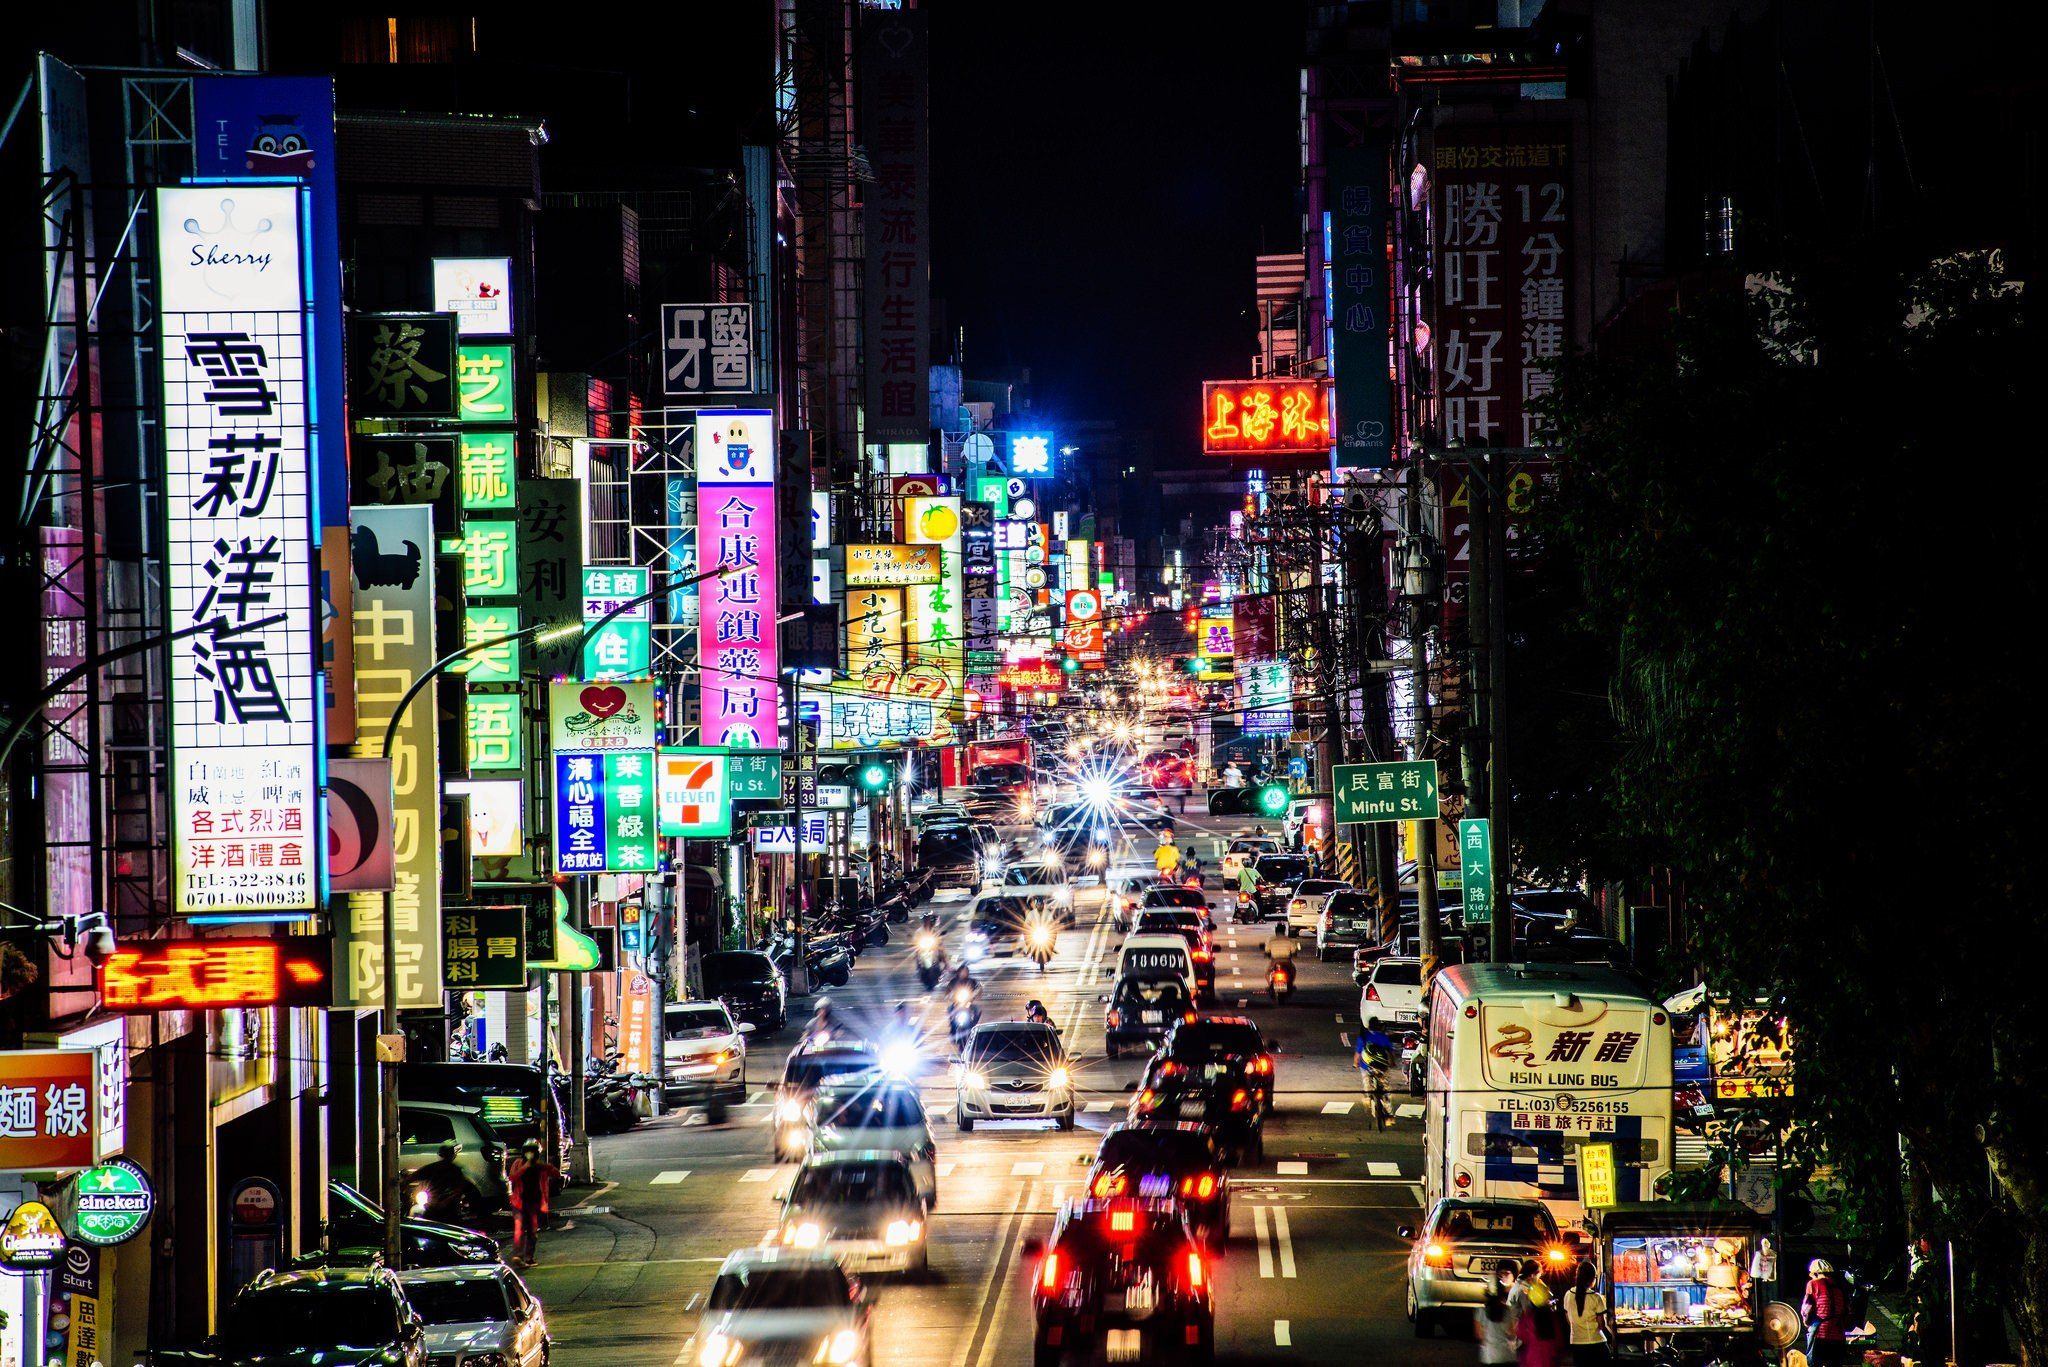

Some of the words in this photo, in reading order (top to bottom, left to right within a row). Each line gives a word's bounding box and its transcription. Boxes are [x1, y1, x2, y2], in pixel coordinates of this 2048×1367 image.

[191, 244, 273, 272] Sherry
[668, 307, 748, 389] 牙醫
[184, 332, 294, 724] 雪莉洋酒
[585, 572, 638, 594] 住商
[716, 497, 762, 719] 合康連鎖藥局
[748, 780, 767, 792] St.
[1351, 770, 1421, 791] 民富街
[568, 757, 595, 851] 清心福全
[1352, 800, 1395, 814] Minfu
[1400, 798, 1423, 812] St.
[191, 808, 303, 835] 各式烈酒
[191, 842, 303, 869] 洋酒禮盒
[1466, 834, 1486, 903] 西大路
[1546, 1031, 1641, 1063] 新龍
[1510, 1071, 1542, 1085] HSIN
[1549, 1073, 1584, 1086] LUNG
[1591, 1074, 1618, 1087] BUS
[0, 1082, 88, 1138] 麵線
[1498, 1098, 1555, 1112] TEL:(03)
[1571, 1101, 1629, 1114] 5256155
[1513, 1113, 1614, 1132] 晶龍旅行社
[78, 1194, 146, 1210] eineken
[63, 1273, 94, 1290] Start
